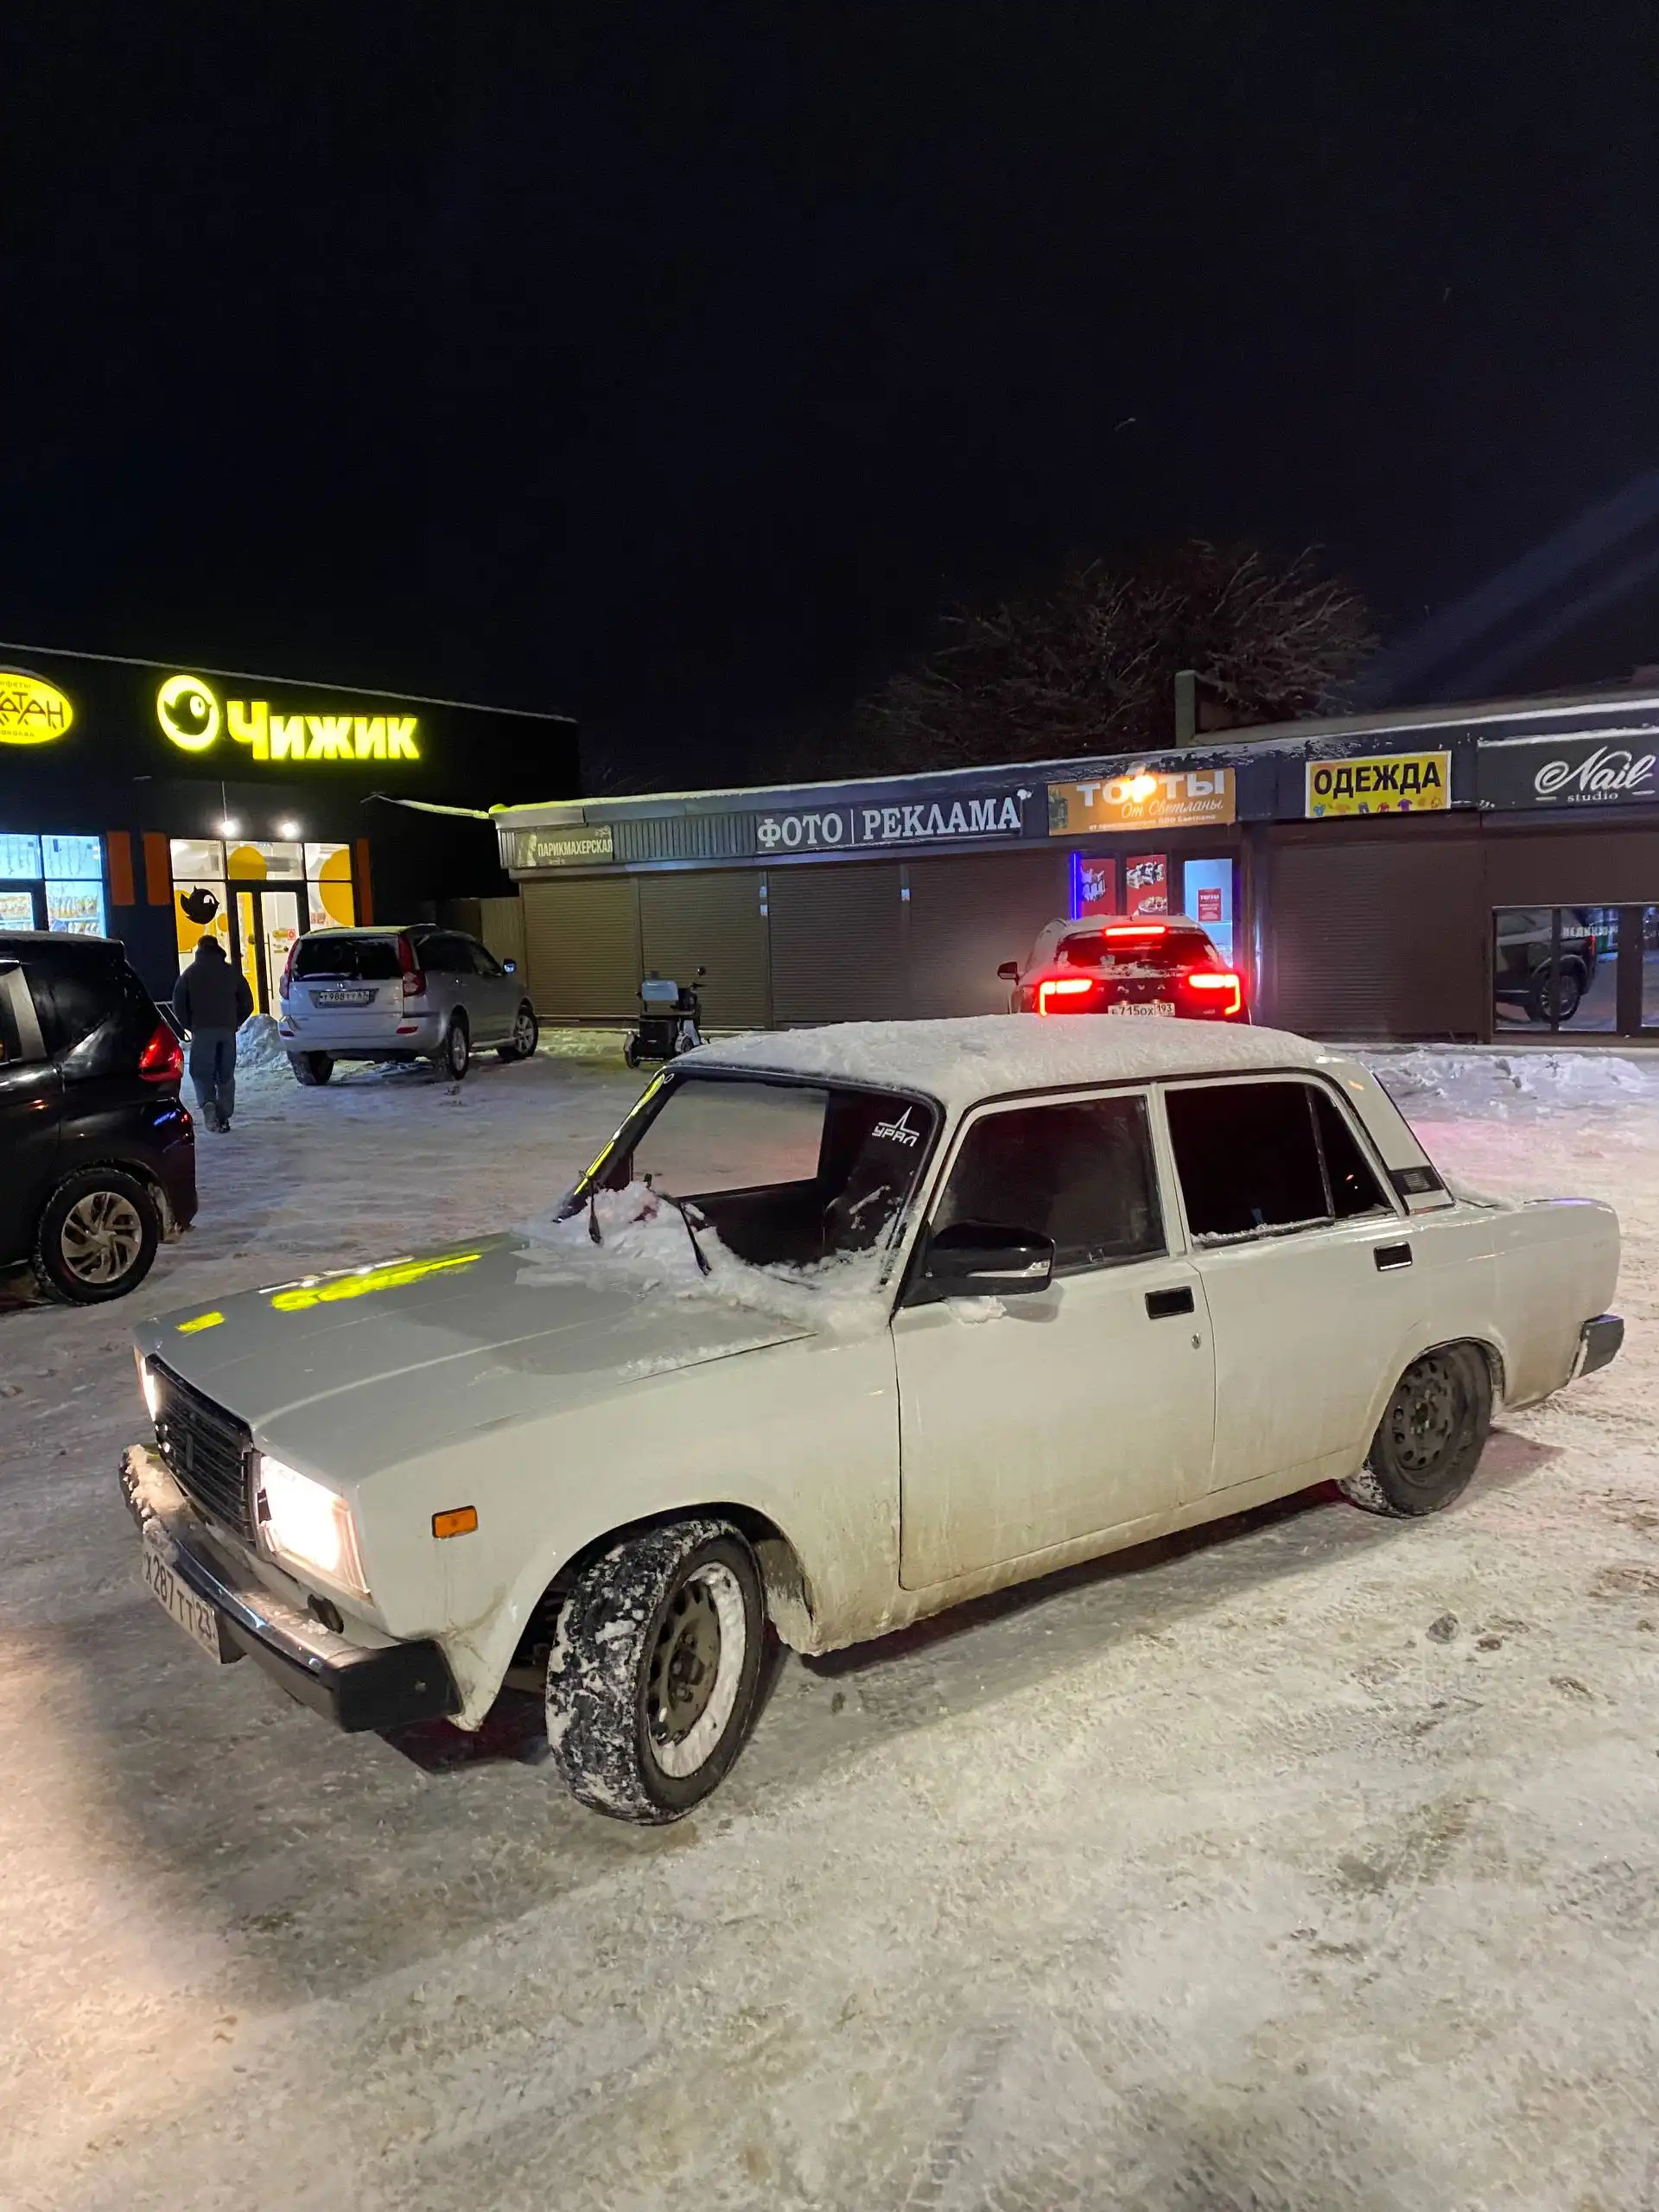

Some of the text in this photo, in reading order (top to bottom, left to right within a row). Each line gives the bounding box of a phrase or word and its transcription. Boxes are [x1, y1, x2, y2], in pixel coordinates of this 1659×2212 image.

[0, 690, 65, 729] АТАН
[1313, 760, 1442, 800] ОДЕЖДА
[1535, 746, 1656, 794] Nail
[1121, 802, 1145, 819] От
[1567, 791, 1618, 803] studio
[757, 797, 1021, 849] ФОТО РЕКЛАМА
